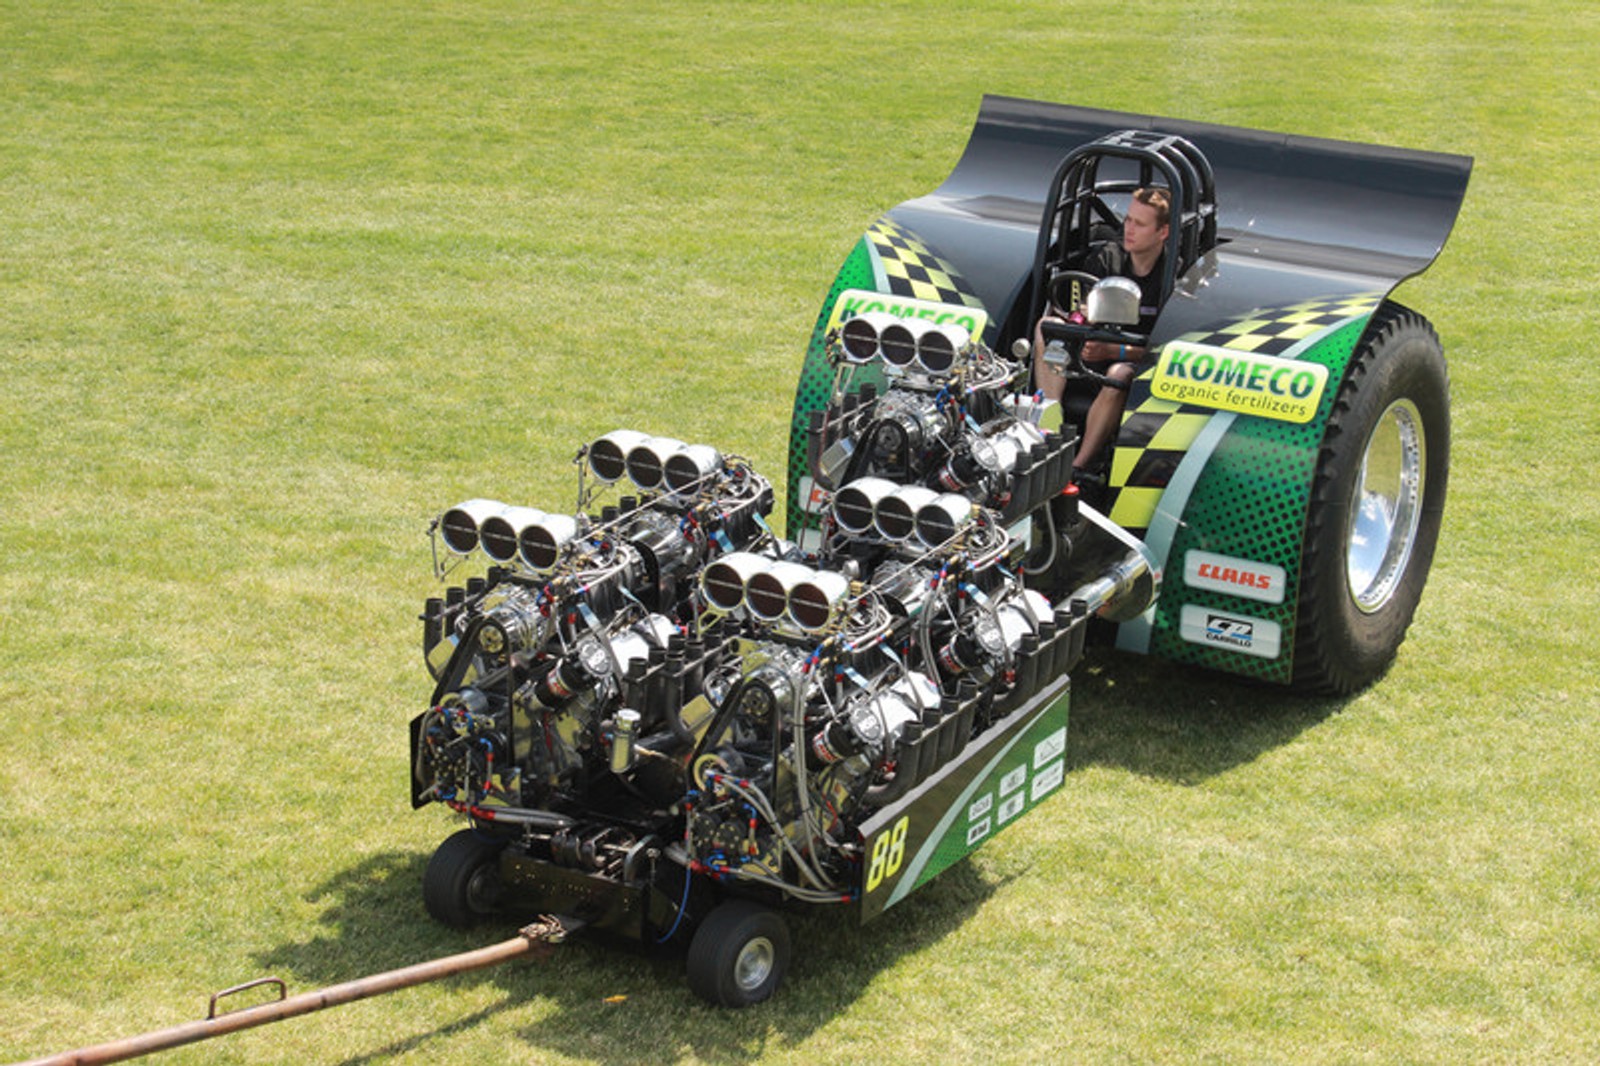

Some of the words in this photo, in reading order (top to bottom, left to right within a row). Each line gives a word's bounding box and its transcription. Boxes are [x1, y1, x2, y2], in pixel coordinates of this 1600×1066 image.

[1166, 350, 1315, 399] KOMECO
[1160, 381, 1219, 401] organic
[1226, 389, 1306, 416] fertilizers
[1198, 563, 1272, 590] CLAAS
[866, 815, 909, 893] 88
